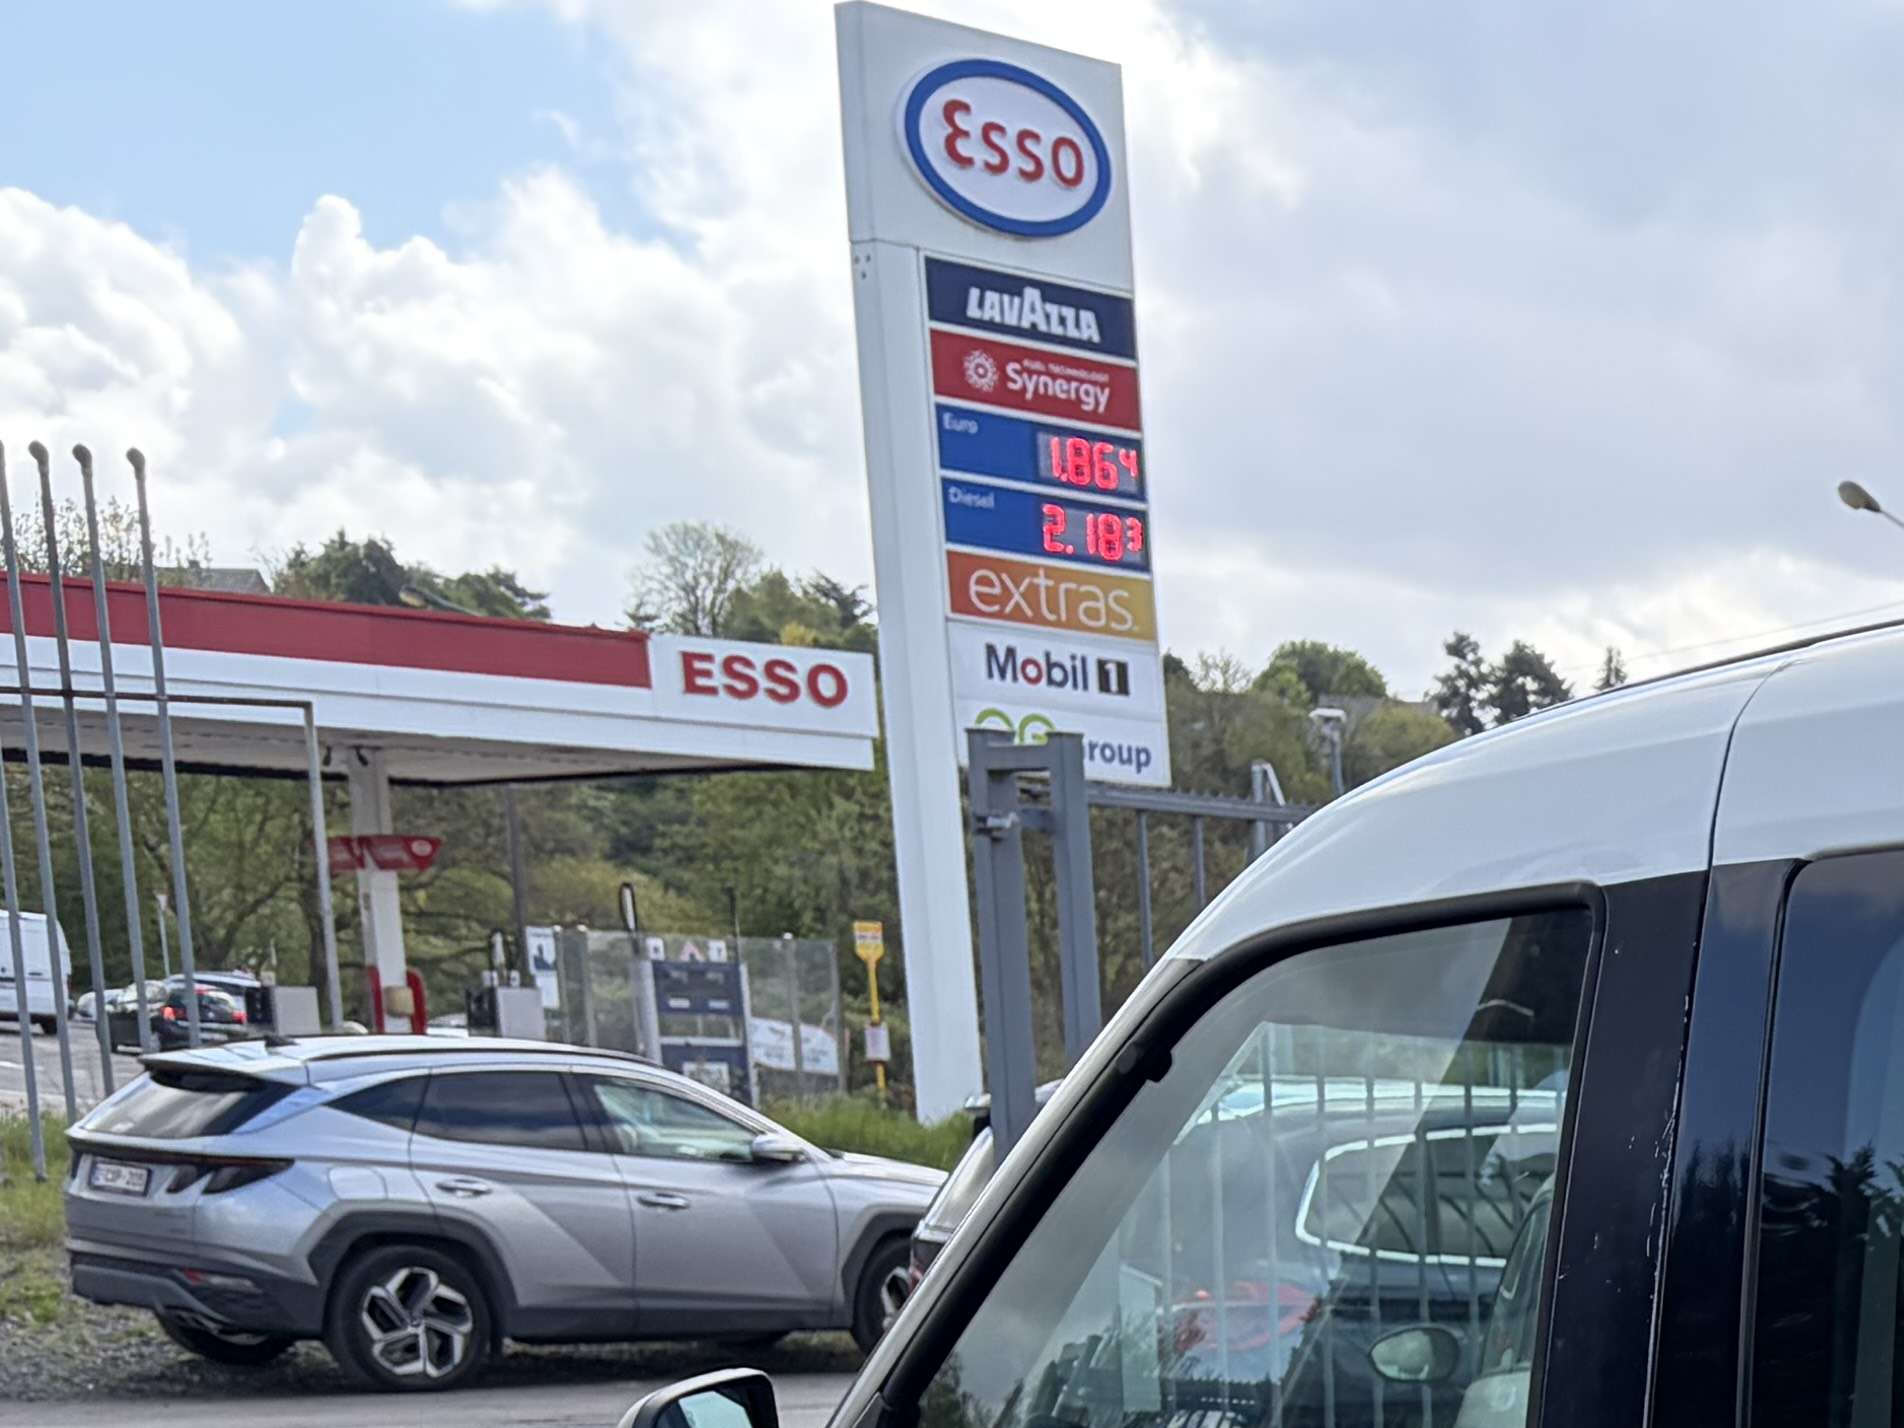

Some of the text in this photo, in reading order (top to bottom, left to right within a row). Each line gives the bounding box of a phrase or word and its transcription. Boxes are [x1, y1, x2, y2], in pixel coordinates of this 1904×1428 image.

[966, 285, 1101, 344] LAVAZZA
[1005, 361, 1110, 414] Synergy
[968, 567, 1131, 632] extras
[680, 651, 848, 709] ESSO
[984, 642, 1121, 693] Mobil 1
[1083, 739, 1152, 774] roup
